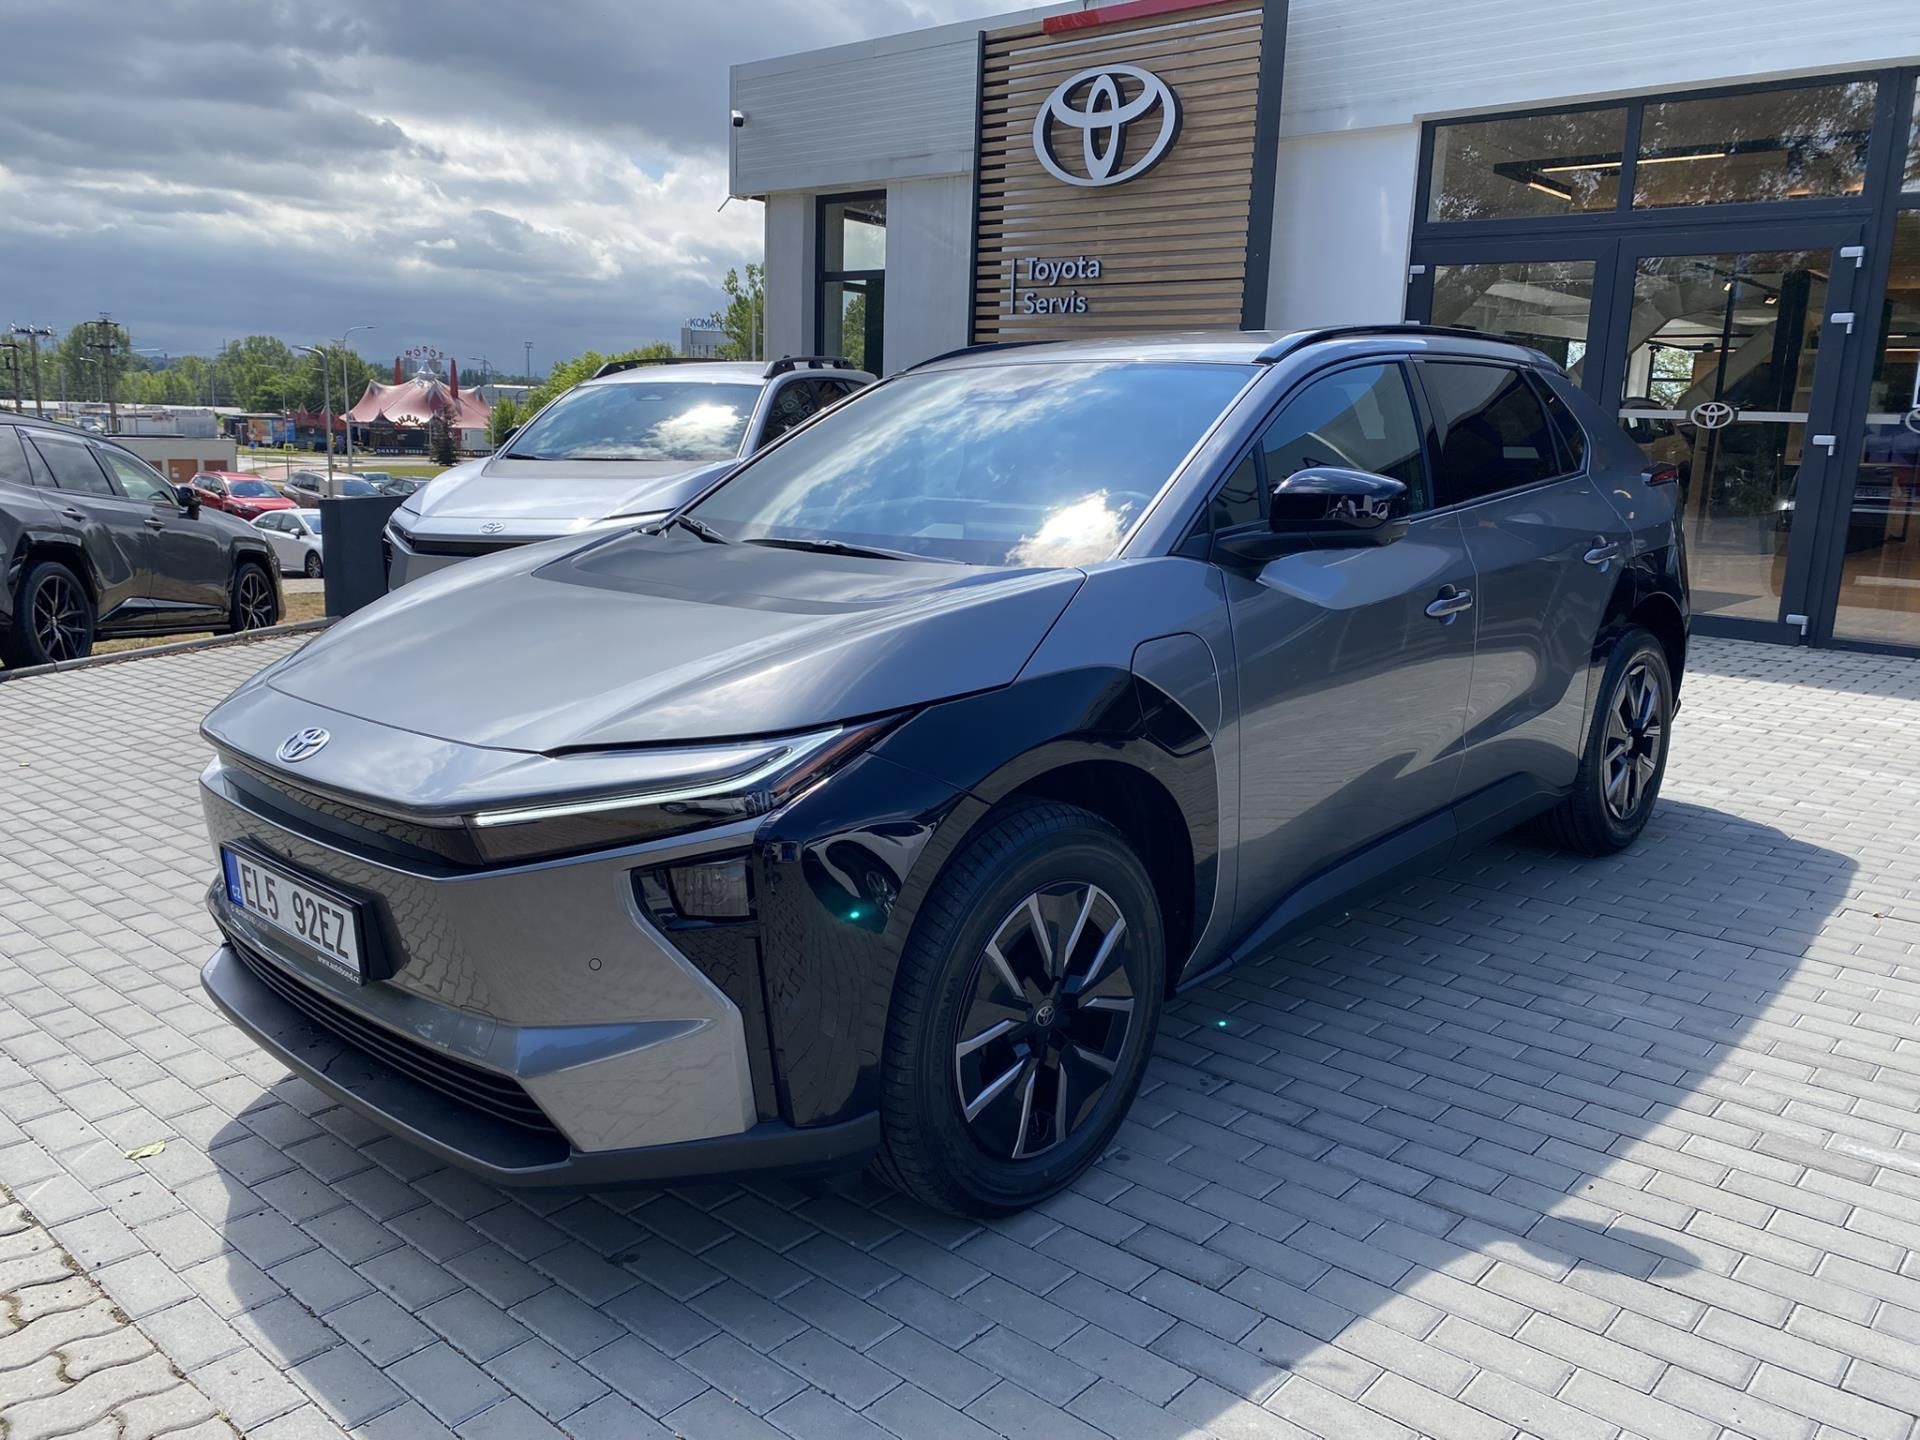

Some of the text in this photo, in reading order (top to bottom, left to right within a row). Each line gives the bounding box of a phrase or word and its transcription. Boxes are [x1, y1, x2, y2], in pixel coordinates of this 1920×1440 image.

[1025, 256, 1101, 286] Toyota
[1023, 290, 1088, 314] Servis
[231, 884, 242, 899] CZ
[241, 863, 278, 920] EL5
[292, 890, 349, 960] 92EZ
